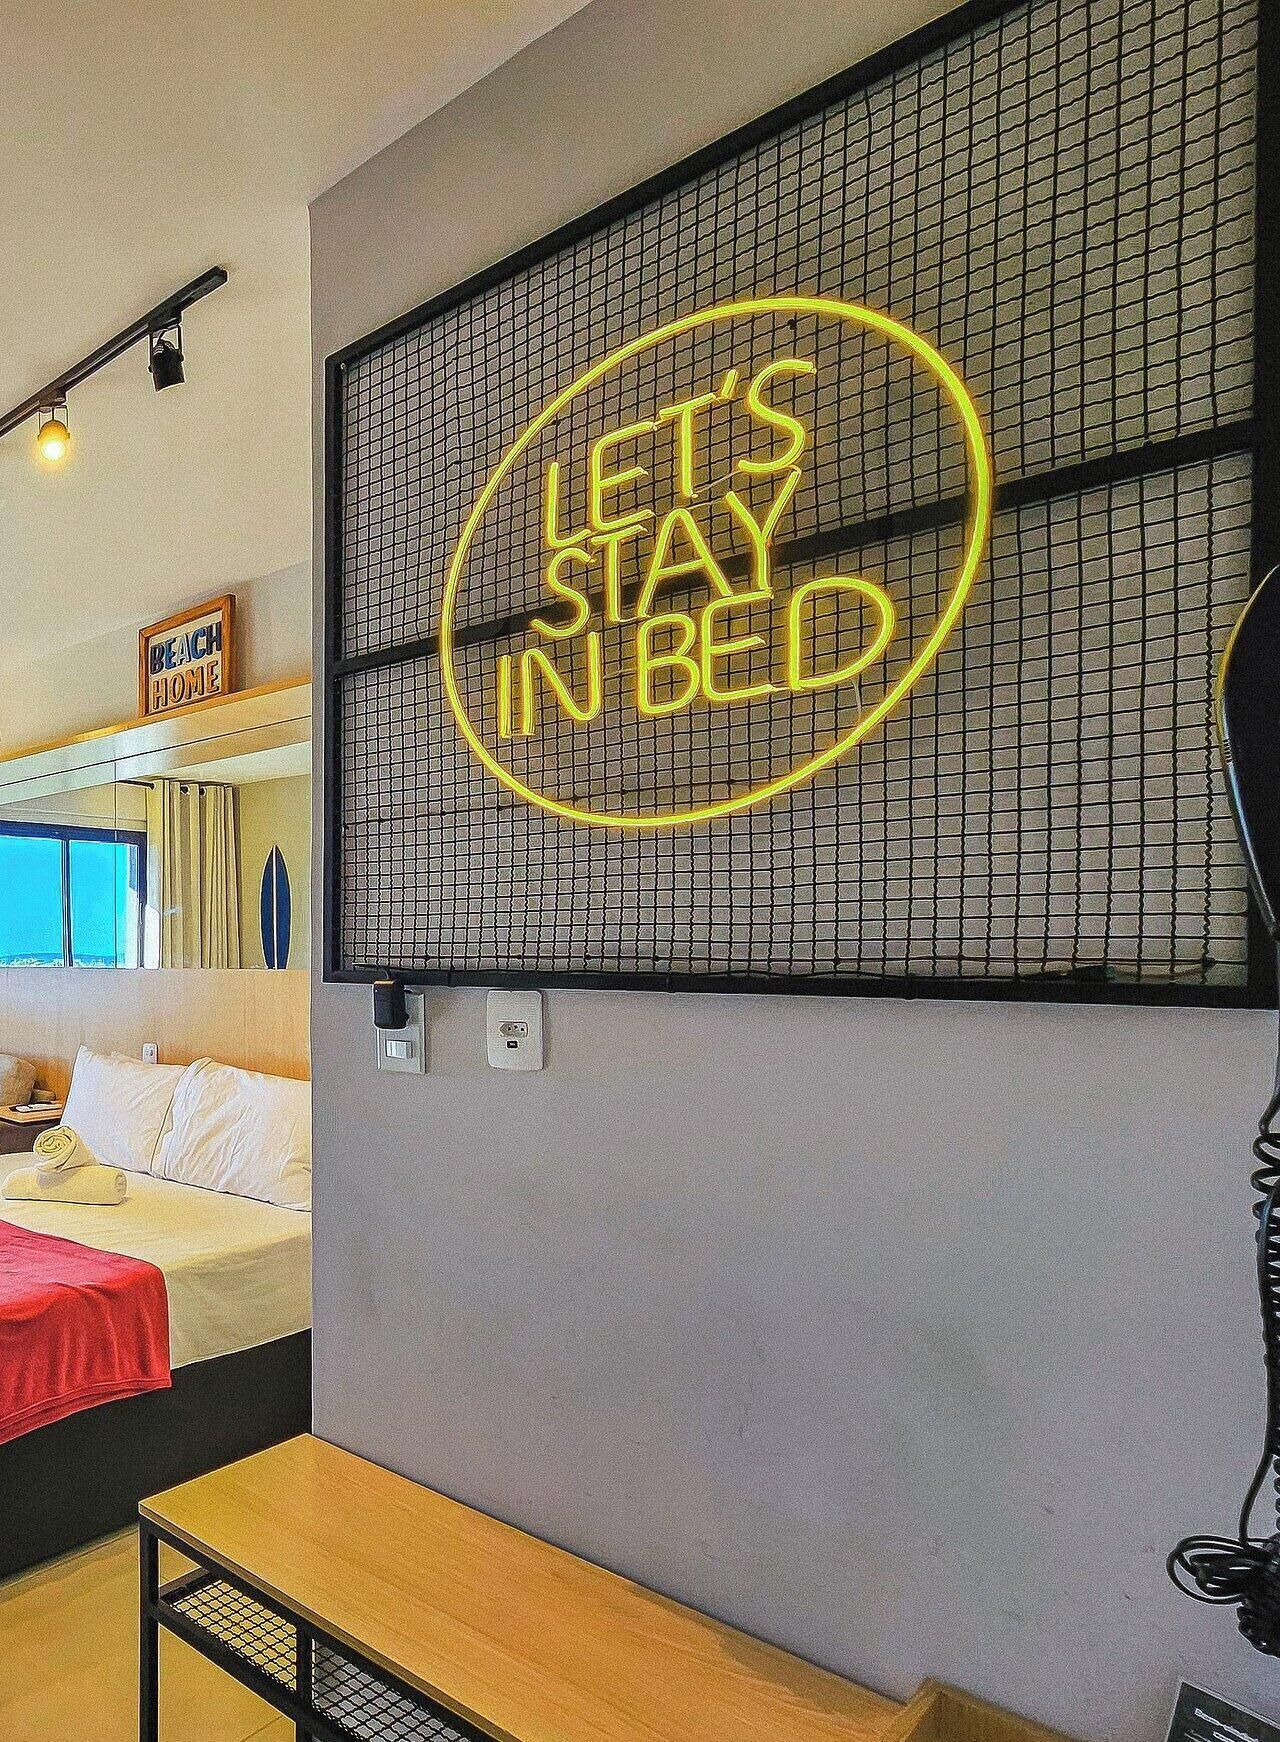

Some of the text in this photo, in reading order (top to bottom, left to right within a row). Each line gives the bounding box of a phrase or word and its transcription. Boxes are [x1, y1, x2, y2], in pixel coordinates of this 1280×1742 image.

[547, 358, 817, 548] LET'S
[531, 466, 801, 638] STAY
[150, 621, 222, 674] BEACH
[152, 660, 220, 710] HOME
[498, 575, 895, 739] IN BED
